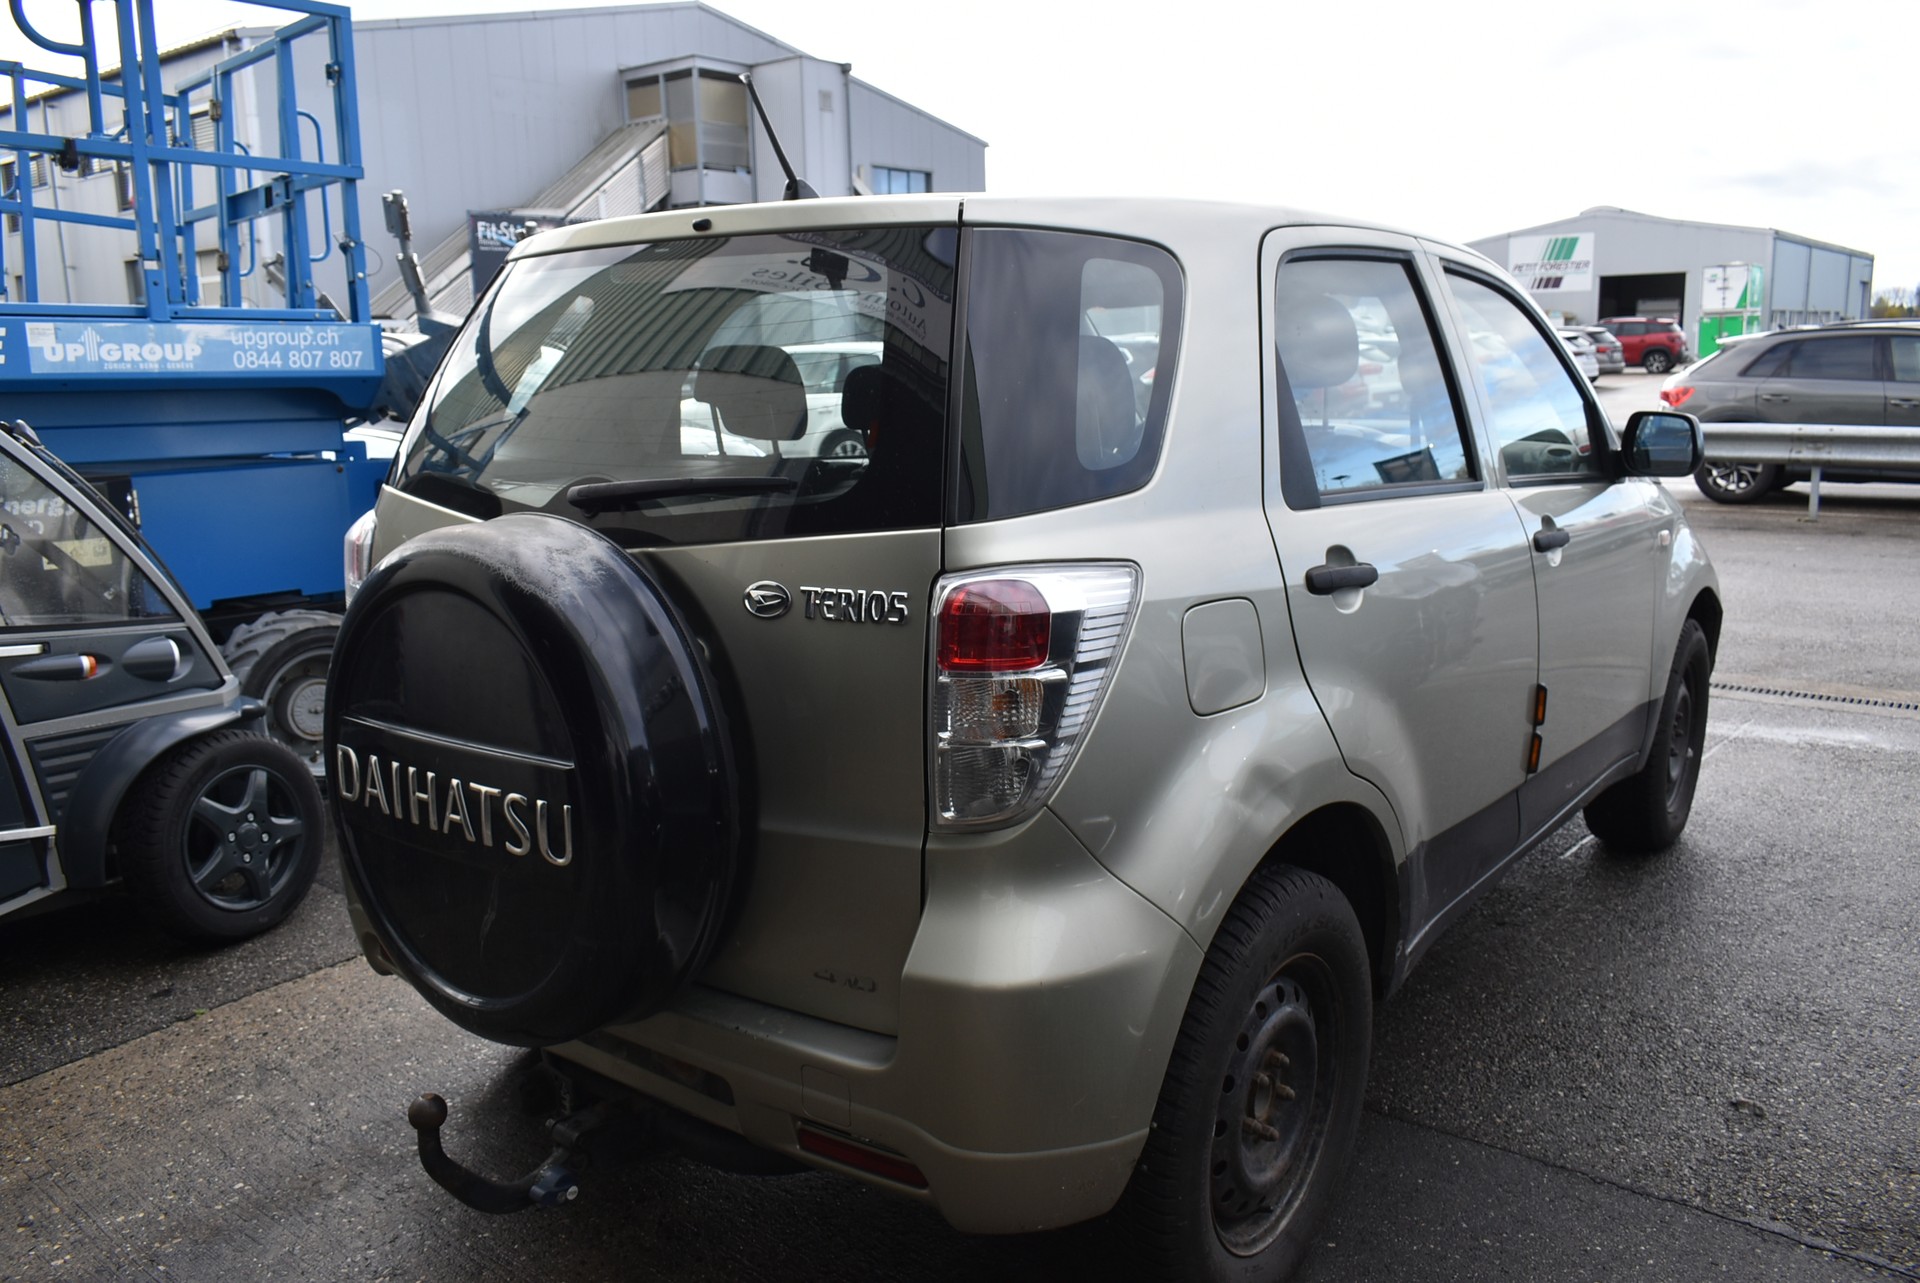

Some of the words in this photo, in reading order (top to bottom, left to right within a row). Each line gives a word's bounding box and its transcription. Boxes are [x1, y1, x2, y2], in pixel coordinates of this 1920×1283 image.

[477, 221, 522, 241] Fit-St
[1513, 262, 1538, 272] PETIT
[1539, 260, 1590, 271] FORESTIER
[231, 329, 339, 350] upgroup.ch
[99, 342, 202, 362] GROUP
[233, 351, 283, 369] 0844
[288, 350, 323, 369] 807
[329, 350, 363, 369] 807
[800, 586, 908, 624] TERIOS
[336, 743, 573, 867] DAIHATSU
